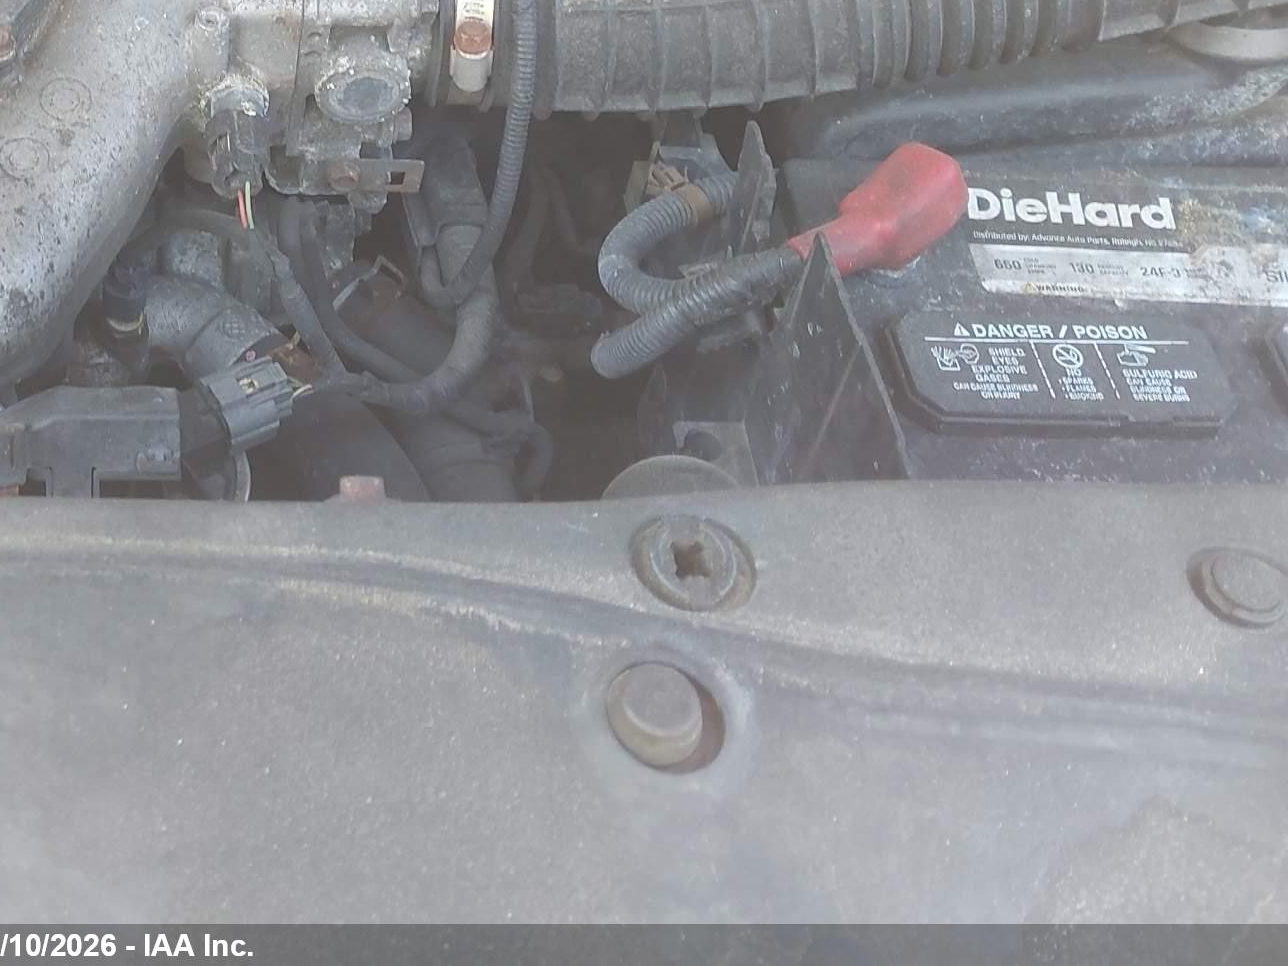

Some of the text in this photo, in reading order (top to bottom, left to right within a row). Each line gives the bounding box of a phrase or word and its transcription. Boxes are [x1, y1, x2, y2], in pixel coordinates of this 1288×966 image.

[968, 187, 1177, 230] DieHard
[973, 230, 1016, 241] Distributed
[1031, 234, 1065, 243] Advance
[972, 324, 1148, 340] DANGER / POISON
[988, 347, 1026, 357] SHIELD
[991, 356, 1020, 366] EYES
[971, 365, 1028, 375] EXPLOSIVE
[1065, 368, 1082, 377] NO
[1122, 368, 1198, 380] SULFURIC ACID
[976, 374, 1010, 383] GASES
[953, 382, 970, 391] CAN
